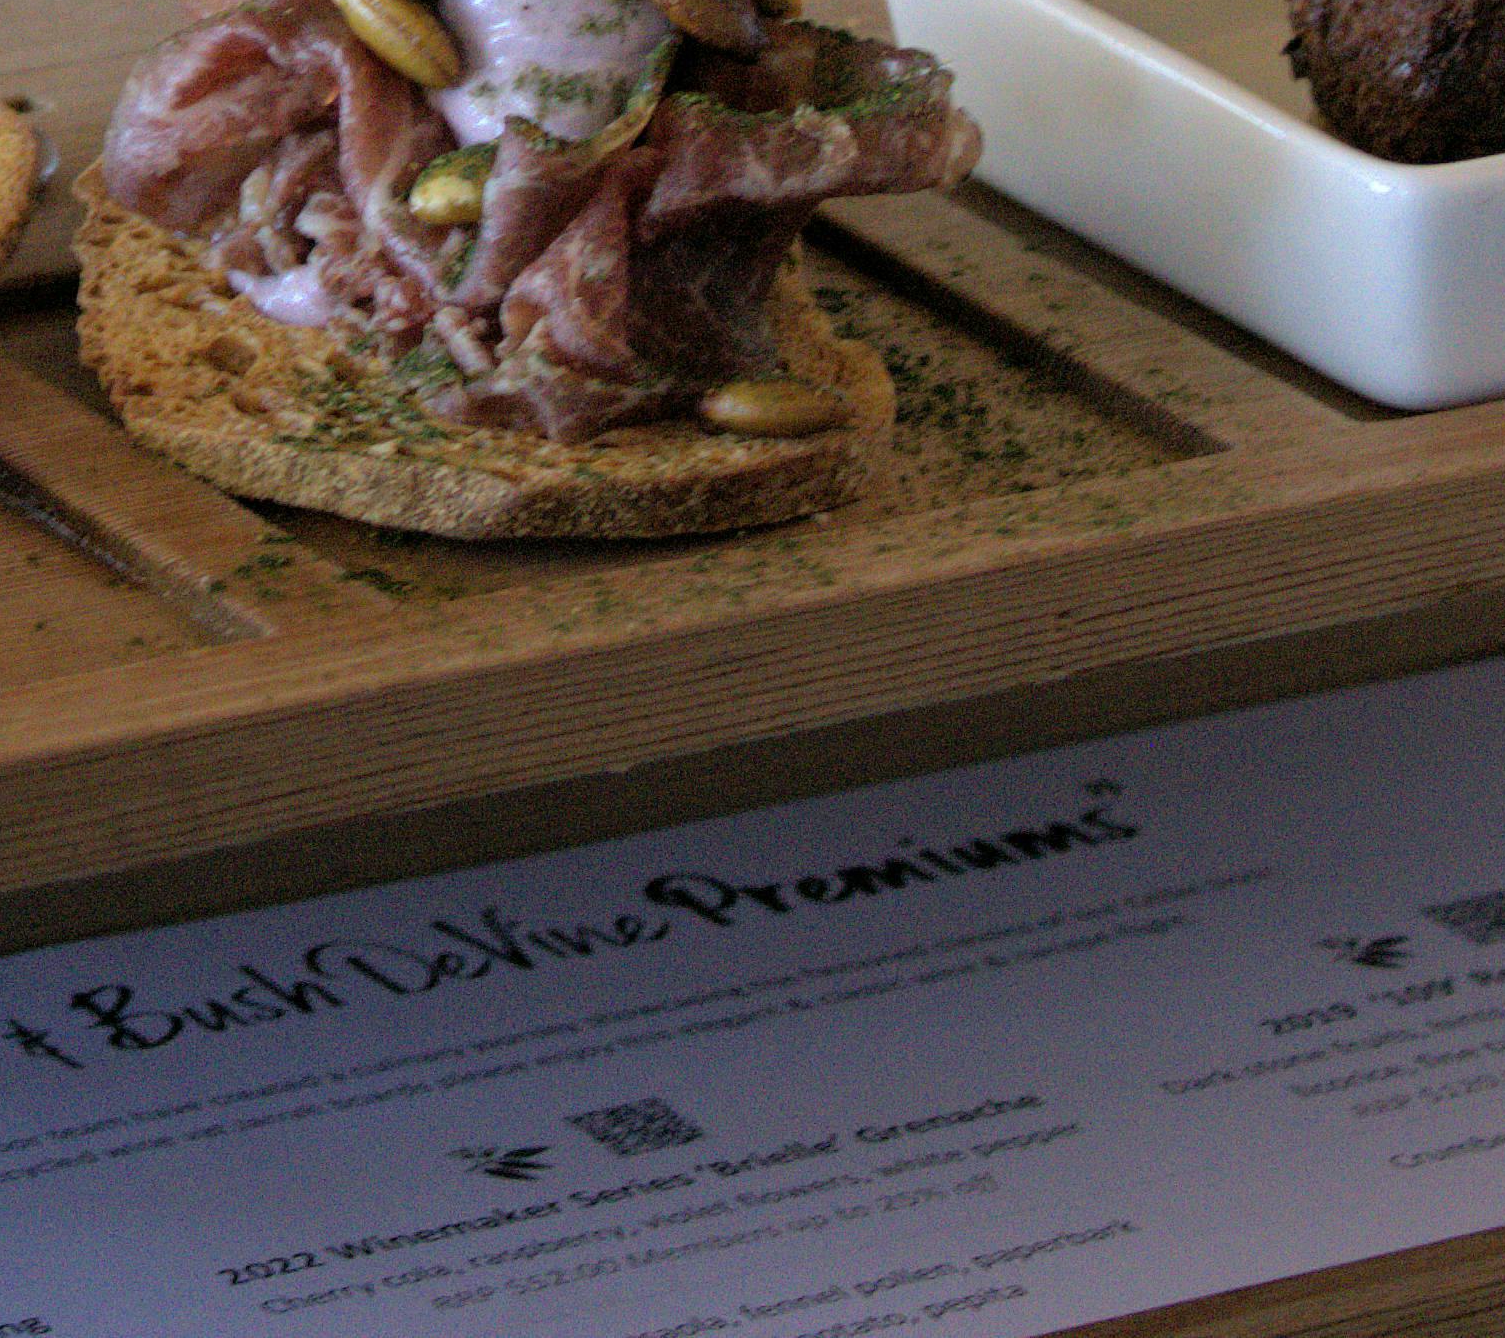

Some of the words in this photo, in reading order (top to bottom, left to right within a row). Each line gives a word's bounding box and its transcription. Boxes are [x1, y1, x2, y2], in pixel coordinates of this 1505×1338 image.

[71, 963, 346, 1053] Bush
[310, 904, 670, 998] DeVine
[643, 777, 1140, 927] Premiums"
[216, 1249, 325, 1287] 2022
[323, 1199, 561, 1261] Winemaker
[566, 1171, 696, 1209] Series
[260, 1276, 377, 1314] Cherry
